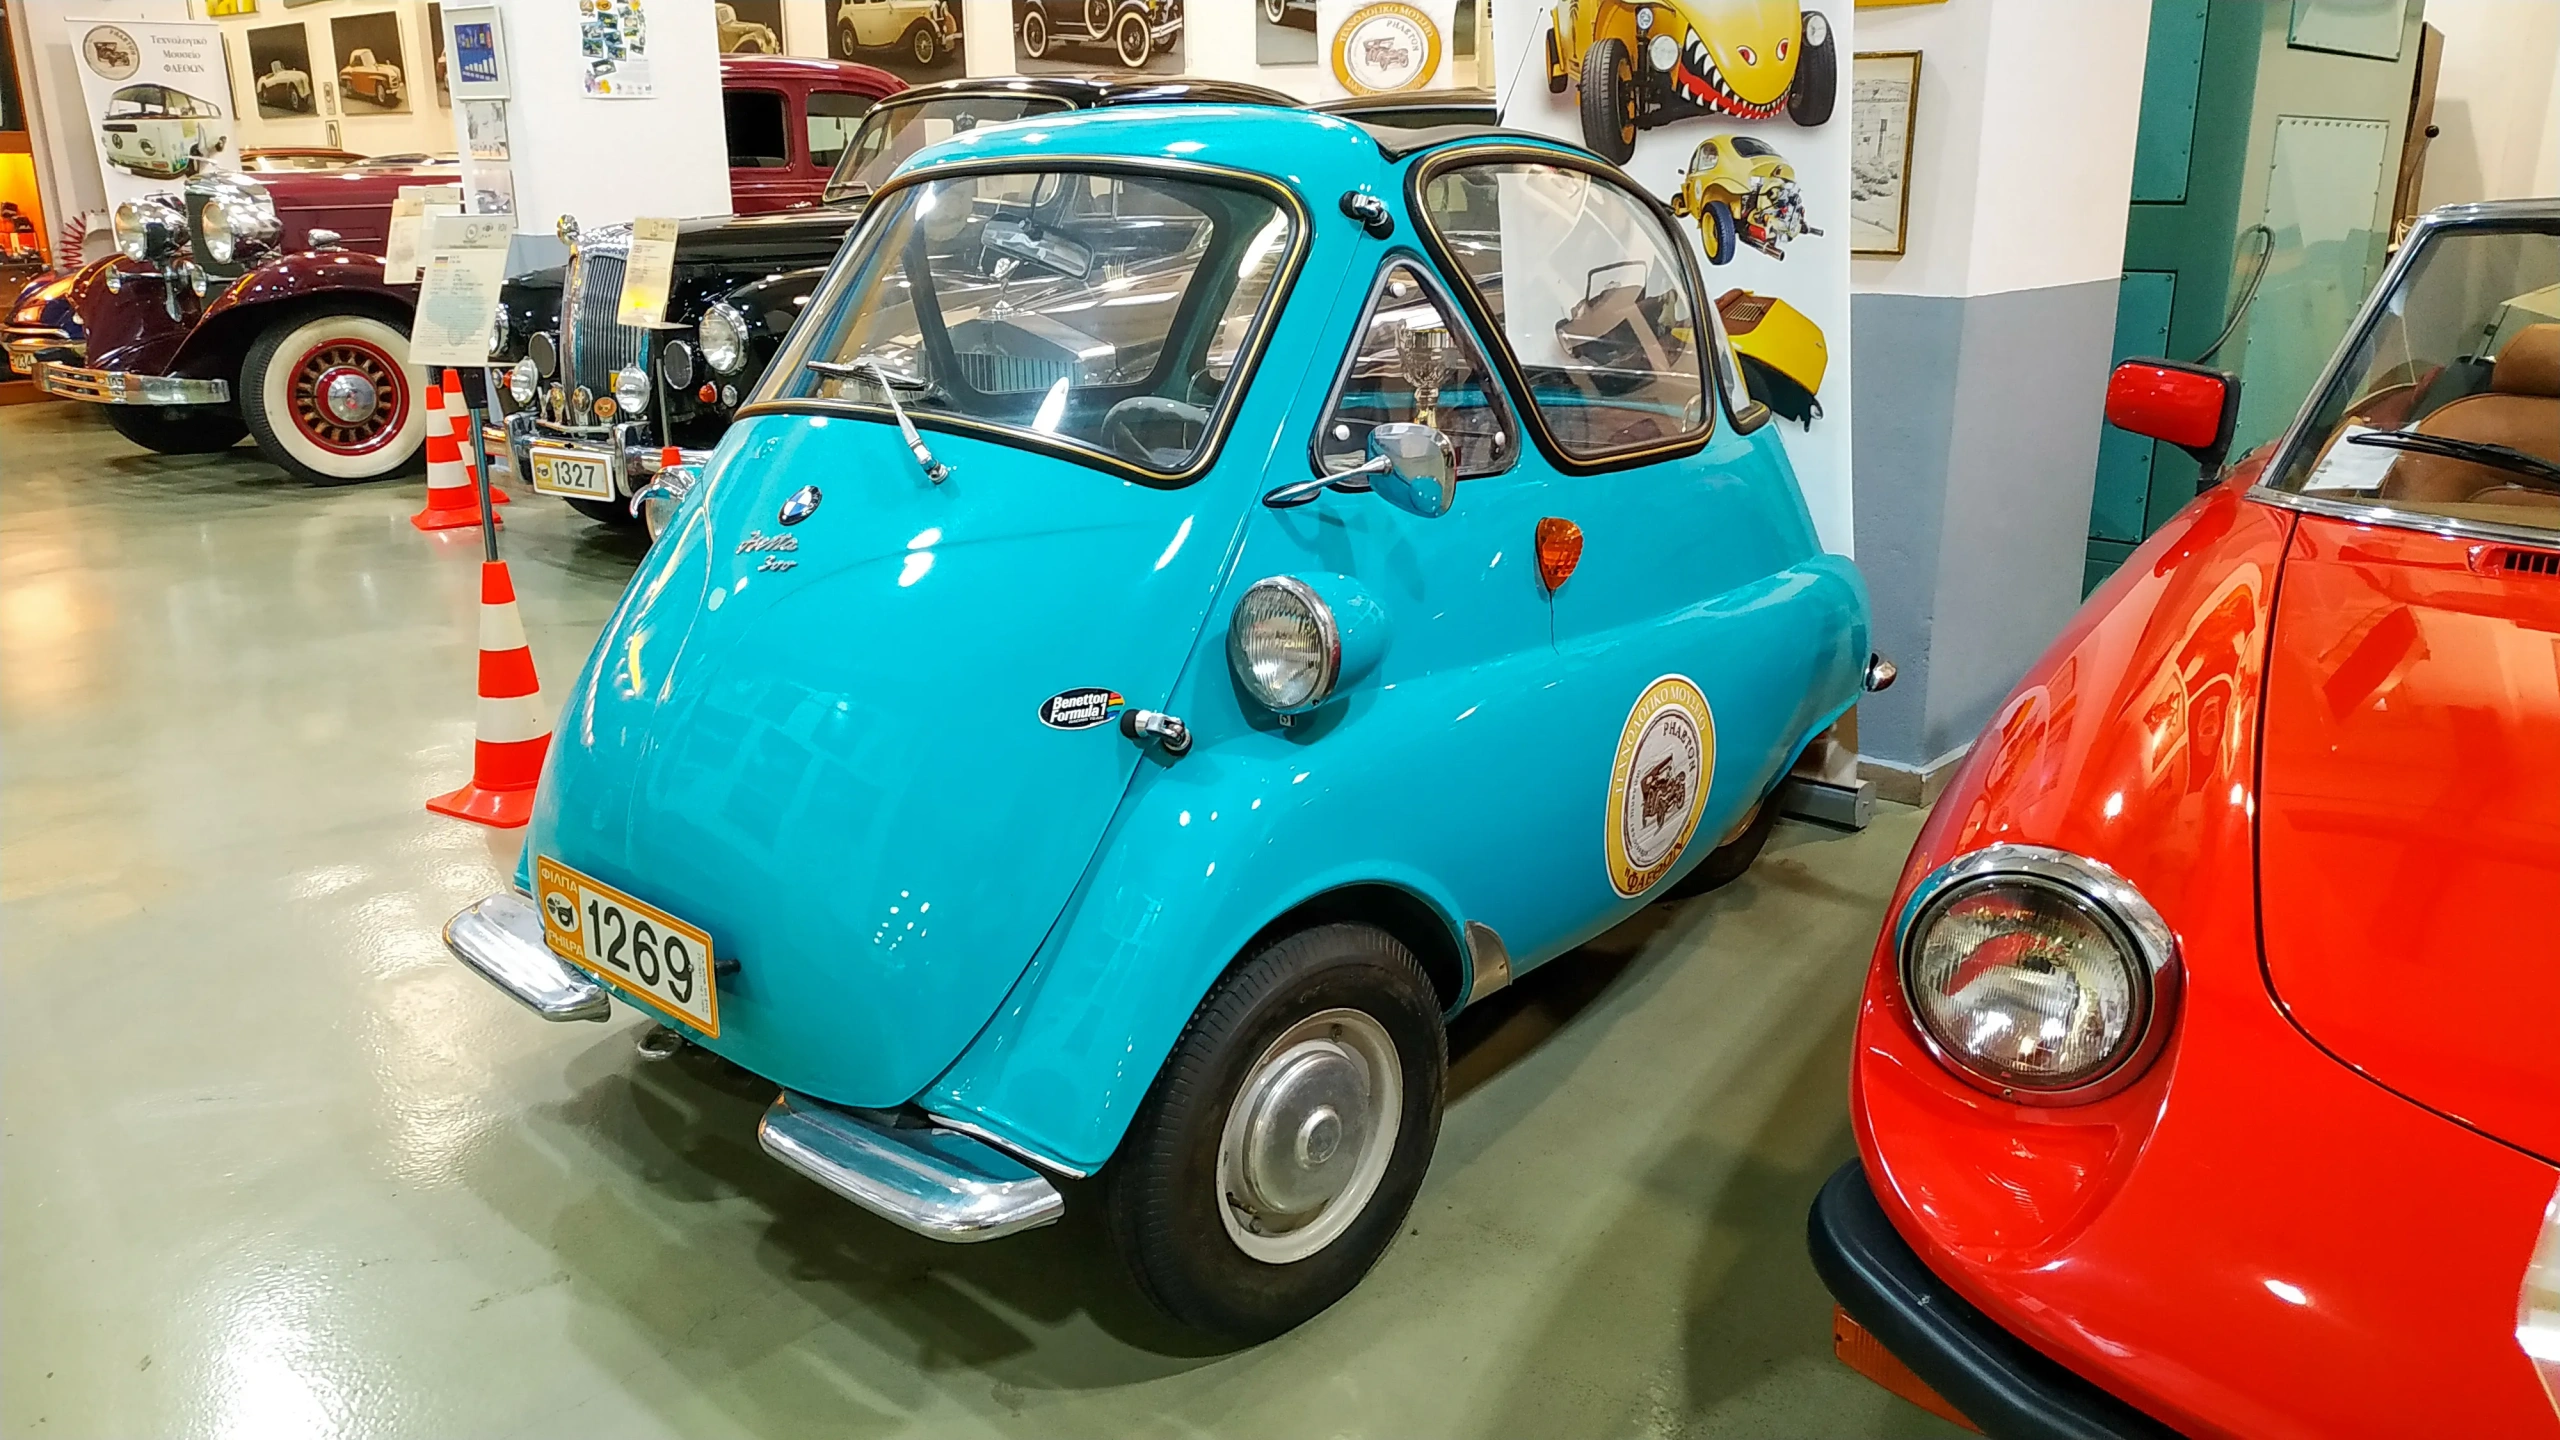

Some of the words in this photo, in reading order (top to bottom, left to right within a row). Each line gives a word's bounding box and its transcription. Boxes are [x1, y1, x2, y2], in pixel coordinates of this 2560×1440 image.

[163, 63, 206, 73] ΦΑΕΘΩΝ
[554, 460, 596, 489] 1327
[1049, 704, 1099, 724] Formula
[1052, 692, 1109, 710] Benetton
[1614, 686, 1669, 796] ΤΕΧΝΟΛΟΓΙΚΟ
[1670, 685, 1706, 732] ΜΟΥΣΕΙΟ
[1662, 721, 1697, 773] PHAETON
[541, 867, 579, 895] ΦΙΛΠΑ
[547, 929, 585, 959] PHILPA
[588, 899, 694, 1003] 1269
